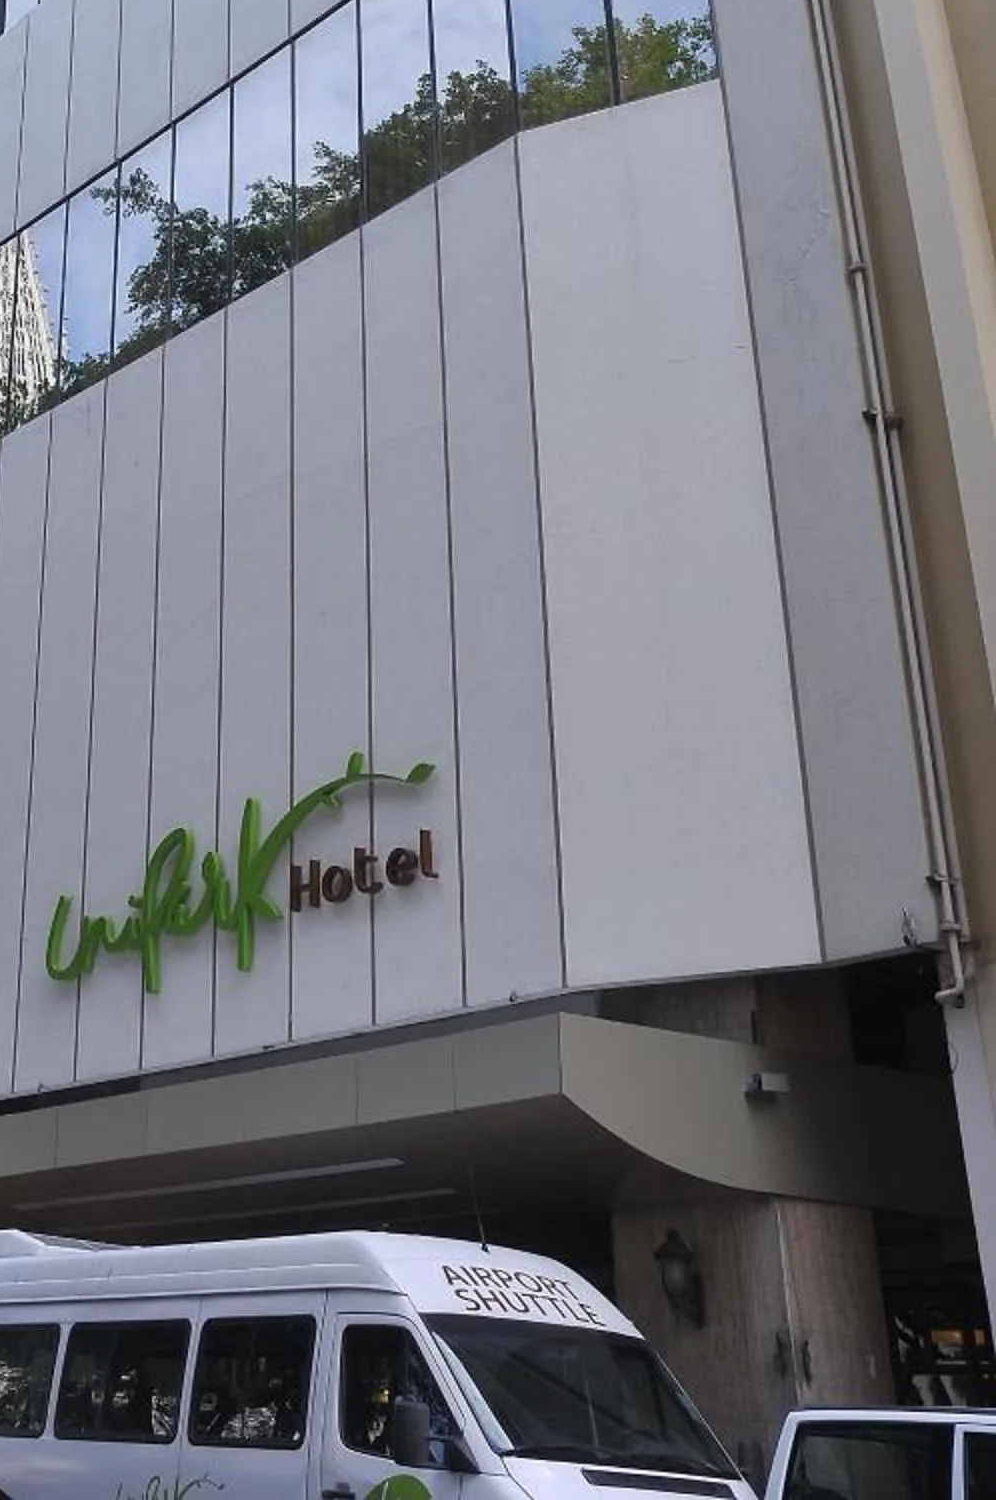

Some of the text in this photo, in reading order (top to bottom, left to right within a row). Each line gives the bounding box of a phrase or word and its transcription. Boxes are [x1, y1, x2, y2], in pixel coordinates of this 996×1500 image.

[290, 829, 438, 912] Hotel
[442, 1265, 579, 1301] AIRPORT
[455, 1288, 607, 1327] SHUTTLE
